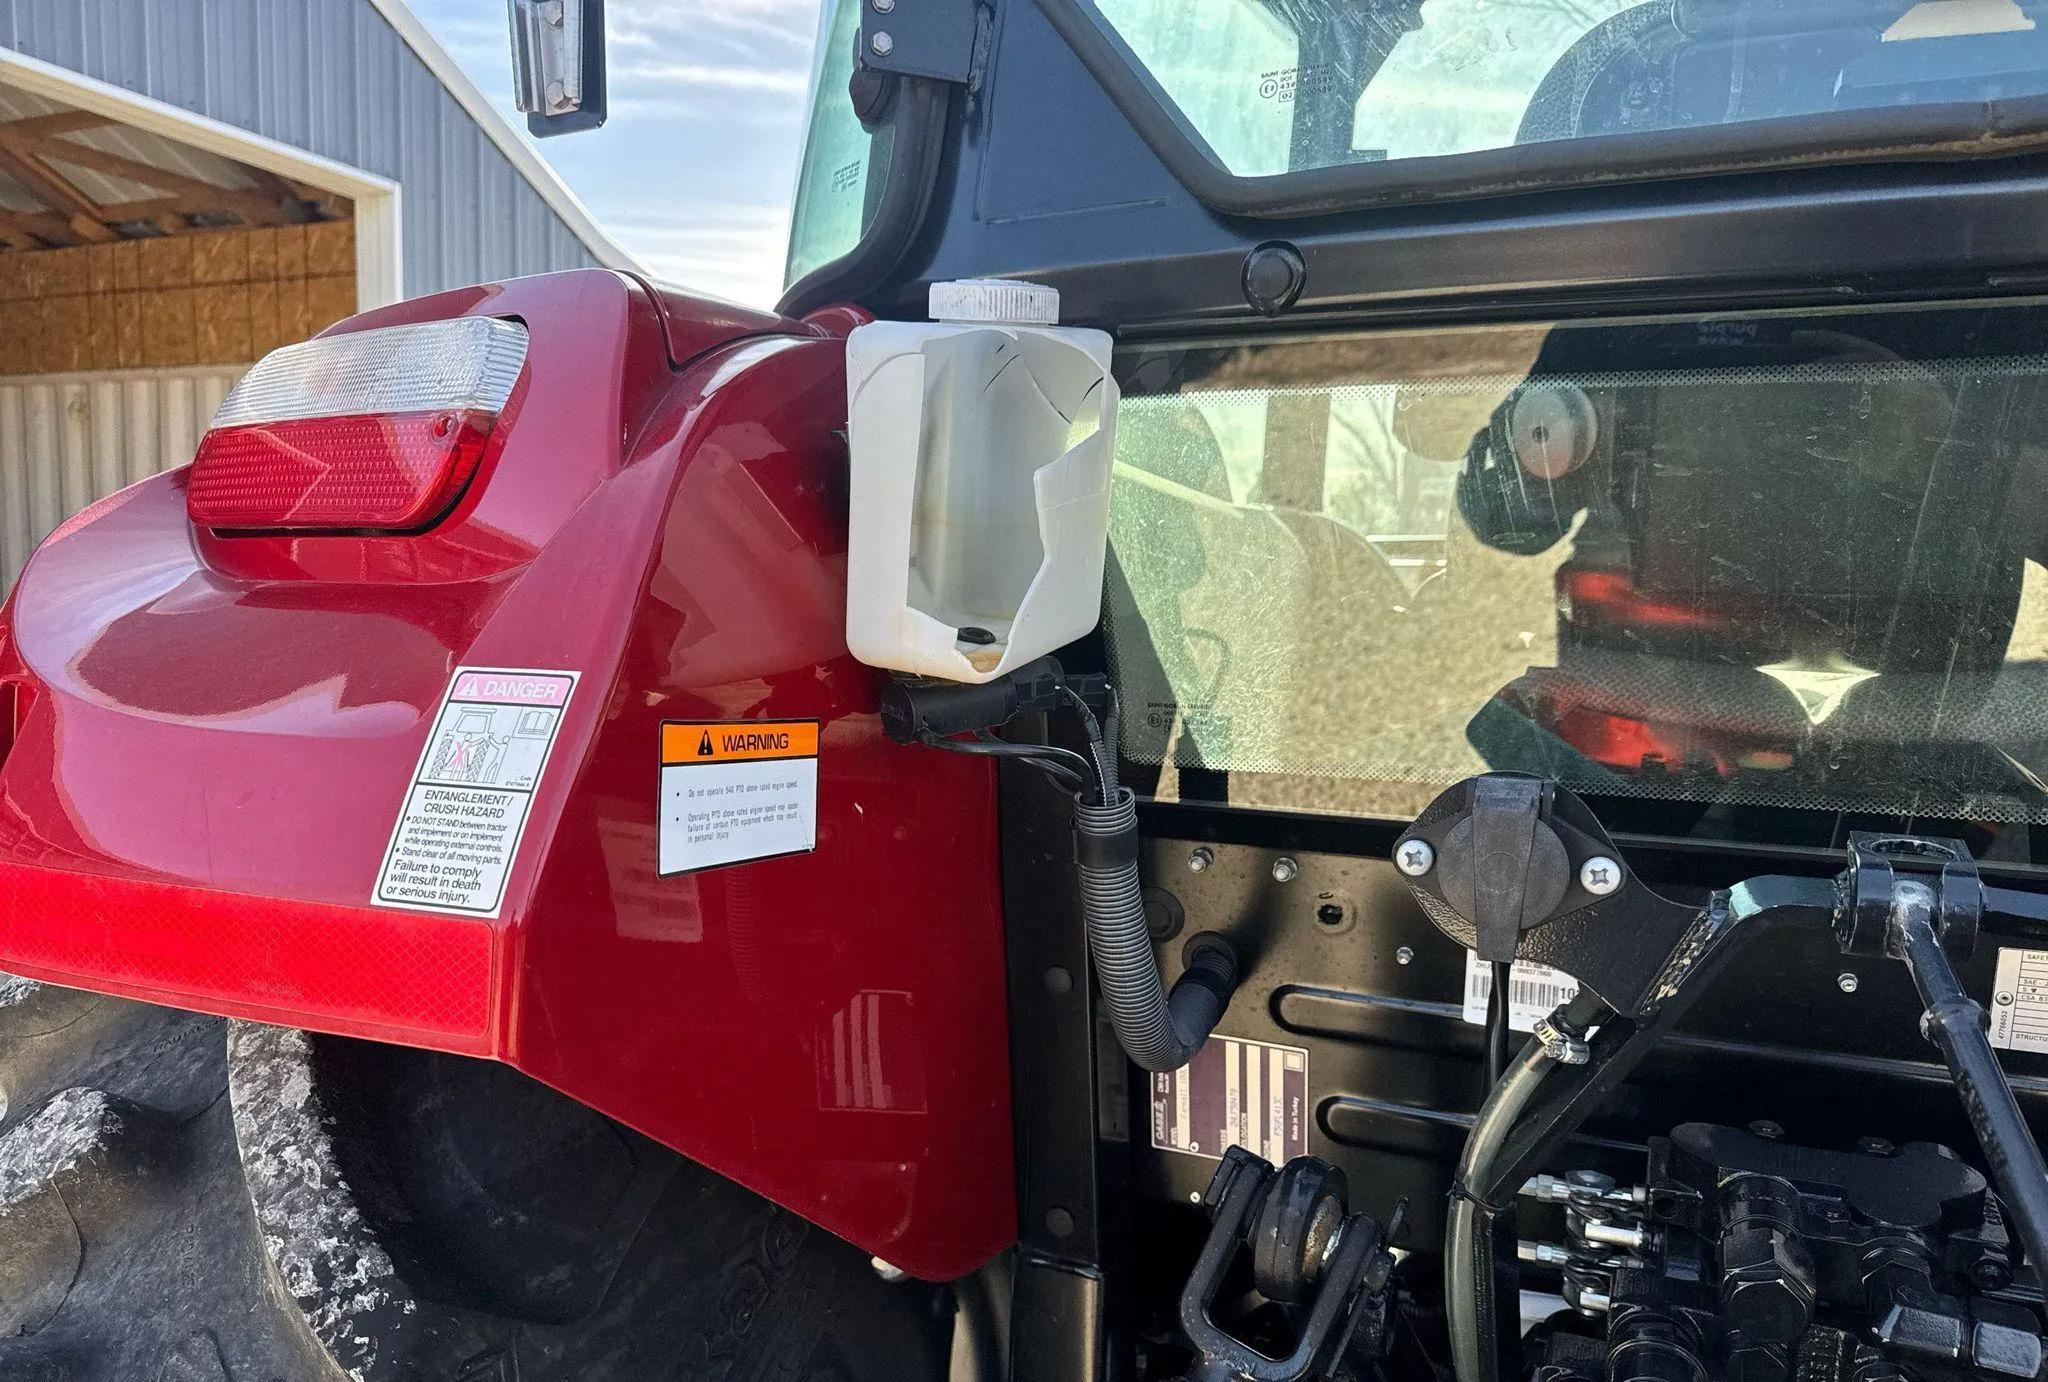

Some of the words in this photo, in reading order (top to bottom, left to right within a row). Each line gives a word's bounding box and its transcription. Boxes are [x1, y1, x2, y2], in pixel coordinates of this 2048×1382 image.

[1261, 70, 1279, 78] SAINT
[483, 680, 559, 698] DANGER
[722, 733, 789, 752] WARNING
[424, 789, 508, 805] ENTANGLEMENT
[688, 789, 696, 798] Do
[697, 788, 705, 797] not
[707, 787, 724, 798] operate
[725, 785, 734, 795] 540
[736, 785, 745, 793] PTO
[746, 784, 758, 793] above
[759, 783, 771, 791] rated
[772, 782, 785, 792] engine
[424, 803, 460, 815] CRUSH
[460, 806, 505, 818] HAZARD
[688, 812, 710, 823] Operating
[711, 810, 721, 820] PTO
[722, 809, 735, 818] above
[736, 808, 748, 816] rated
[750, 806, 763, 816] engine
[764, 804, 777, 814] speed
[787, 802, 798, 810] cause
[411, 816, 422, 824] DO
[422, 817, 437, 826] NOT
[437, 818, 459, 827] STAND
[459, 820, 486, 829] between
[486, 822, 508, 832] tractor
[688, 823, 704, 833] failure
[705, 822, 711, 830] of
[713, 820, 729, 830] certain
[730, 819, 739, 827] PTO
[740, 816, 761, 827] equipment
[763, 814, 774, 823] which
[776, 814, 784, 822] may
[785, 812, 798, 820] result
[407, 826, 420, 834] and
[420, 827, 453, 838] implement
[469, 832, 503, 842] implement
[694, 833, 714, 844] personal
[404, 837, 420, 845] while
[421, 838, 450, 849] operating
[450, 841, 476, 850] external
[476, 842, 503, 853] controls.
[401, 846, 421, 857] Stand
[421, 848, 439, 858] clear
[439, 850, 446, 859] of
[446, 851, 455, 860] all
[456, 852, 482, 864] moving
[481, 855, 502, 865] parts.
[393, 859, 428, 873] Failure
[430, 863, 440, 874] to
[442, 866, 482, 880] comply
[390, 872, 407, 883] will
[408, 875, 437, 887] result
[439, 877, 449, 888] in
[451, 878, 482, 891] death
[386, 885, 398, 895] or
[399, 886, 437, 899] serious
[438, 889, 471, 904] injury.
[1291, 1096, 1300, 1117] Turkey
